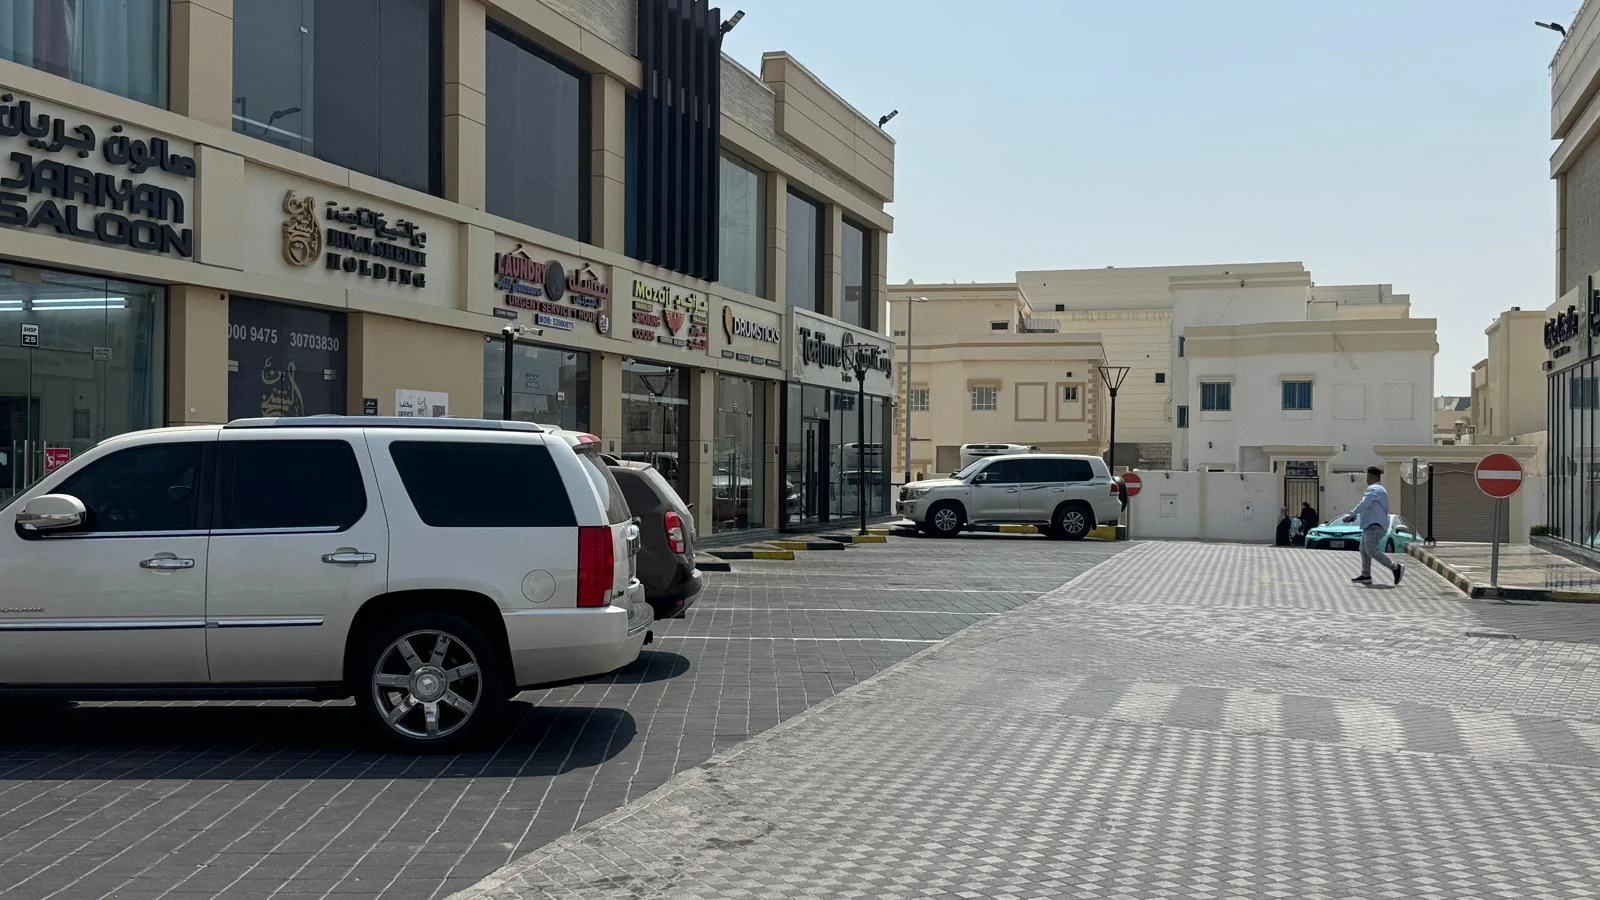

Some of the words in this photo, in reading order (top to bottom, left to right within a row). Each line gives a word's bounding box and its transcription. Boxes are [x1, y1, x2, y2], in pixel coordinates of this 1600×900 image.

[103, 125, 196, 177] صالون
[1, 151, 184, 224] JARIYAN
[0, 191, 192, 257] SALOON
[326, 252, 426, 288] HOLDING
[495, 252, 546, 285] LAUNDRY
[506, 294, 539, 311] URGENT
[634, 280, 671, 307] Mazaji
[24, 335, 37, 343] 25
[250, 326, 278, 344] 9475
[290, 332, 340, 351] 30703830
[733, 317, 780, 344] DRUMSTICKS
